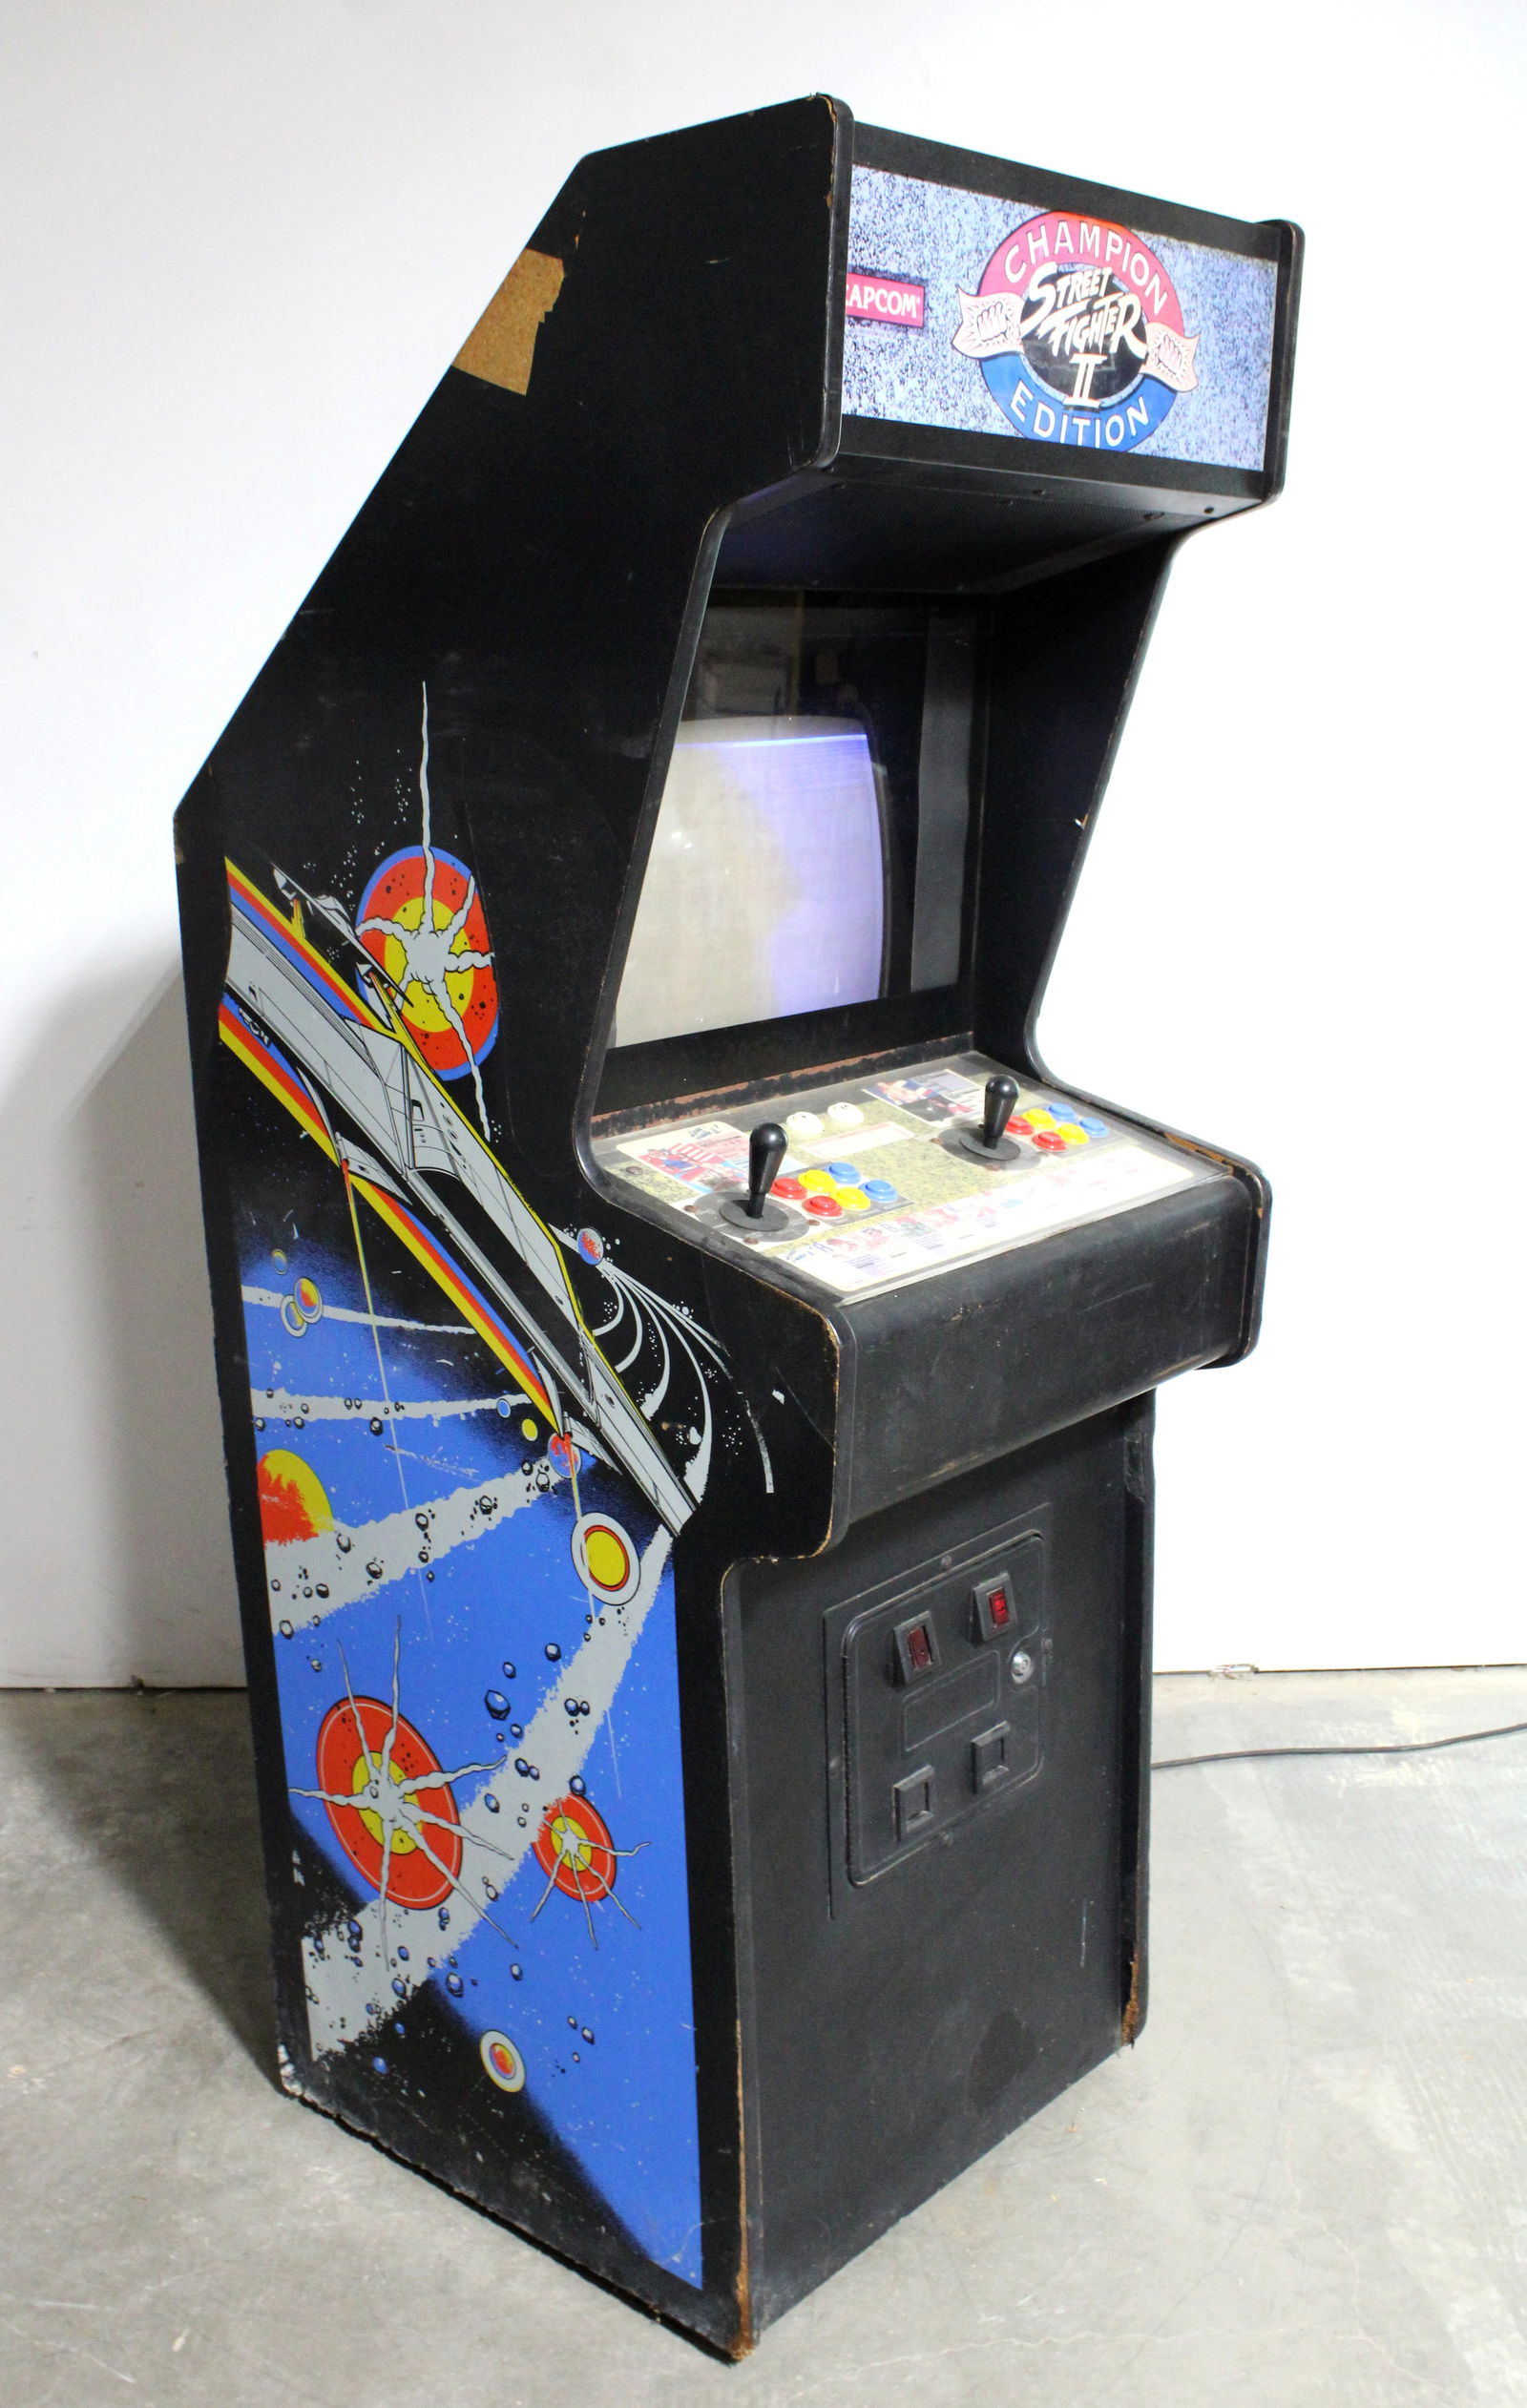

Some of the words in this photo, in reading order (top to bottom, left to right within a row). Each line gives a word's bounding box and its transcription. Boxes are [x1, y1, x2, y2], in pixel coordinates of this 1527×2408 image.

[846, 283, 917, 319] APCOM
[1004, 220, 1168, 315] CHAMPION
[1019, 261, 1113, 339] STREET
[1035, 291, 1148, 360] FIGHTER
[1010, 379, 1150, 449] EDITION
[1061, 352, 1108, 408] II
